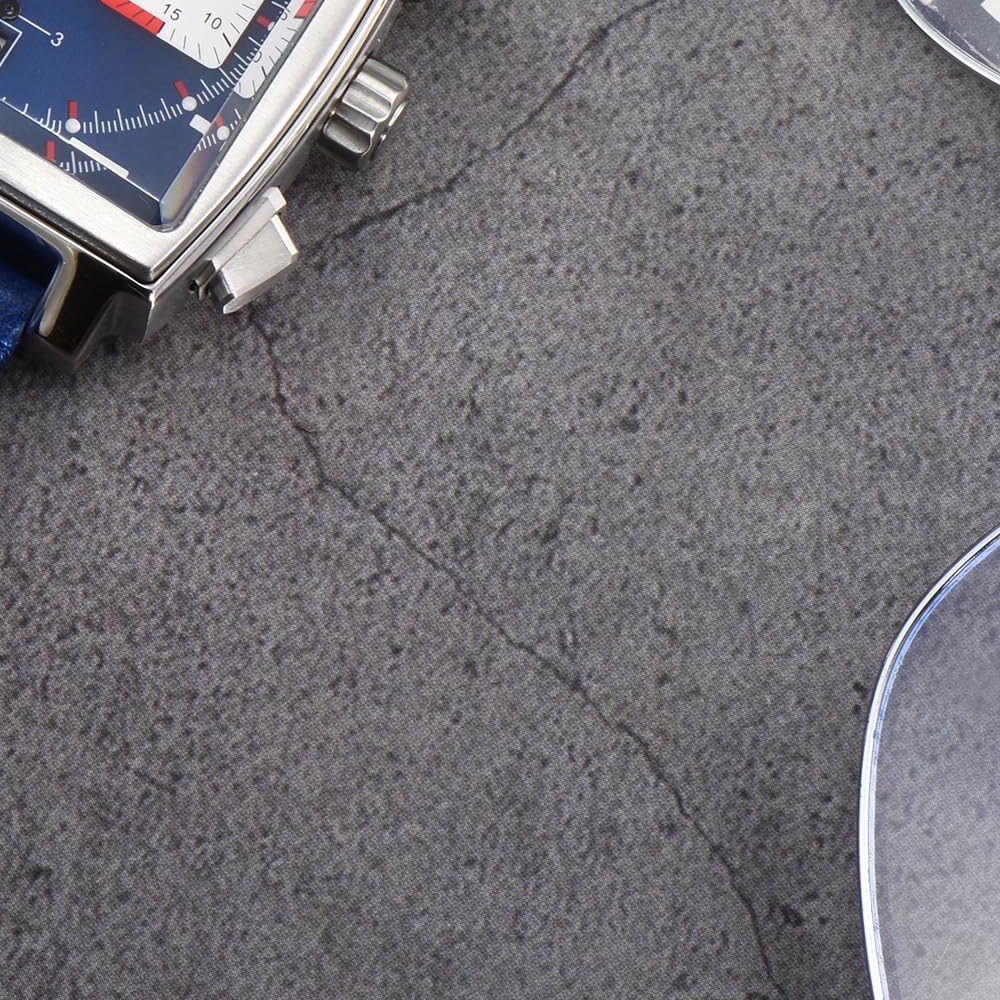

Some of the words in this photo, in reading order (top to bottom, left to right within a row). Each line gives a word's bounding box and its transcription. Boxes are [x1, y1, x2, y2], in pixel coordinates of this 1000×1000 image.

[162, 3, 182, 21] 15
[203, 12, 223, 30] 10
[51, 32, 65, 47] 3
